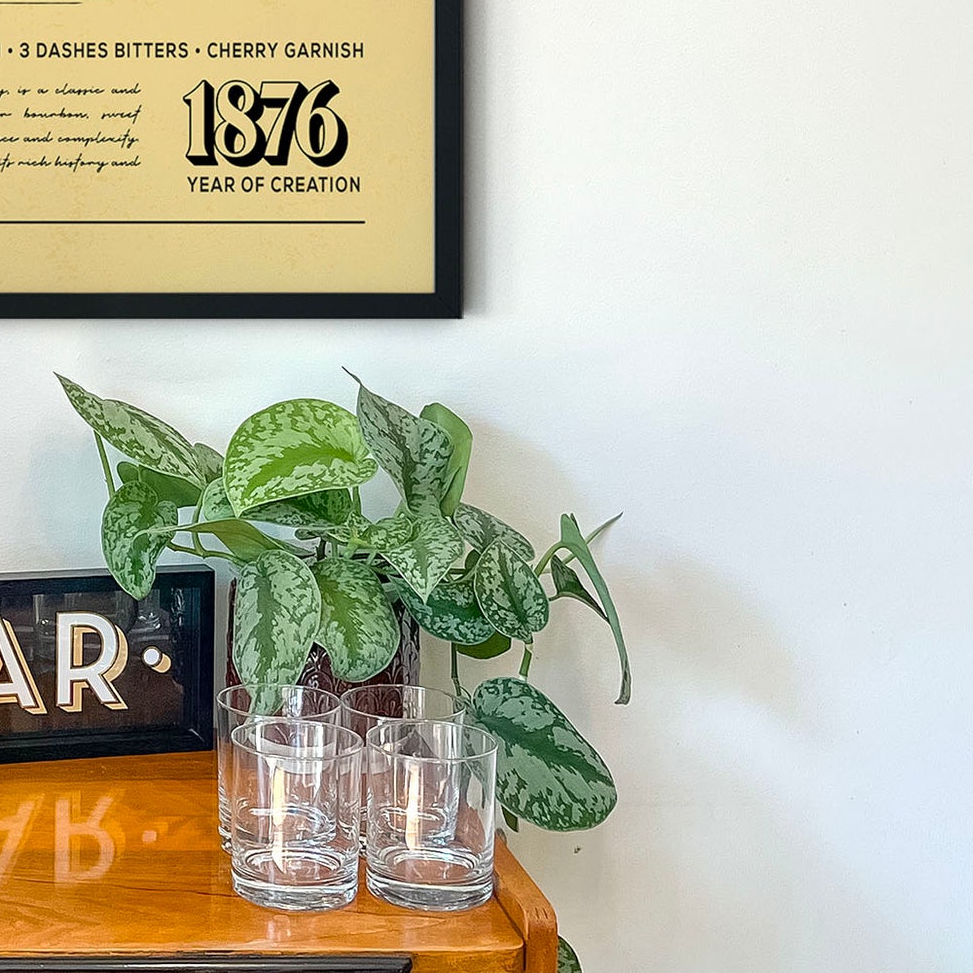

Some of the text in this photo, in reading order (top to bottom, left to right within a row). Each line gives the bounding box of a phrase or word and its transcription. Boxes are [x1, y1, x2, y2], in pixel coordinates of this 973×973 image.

[19, 42, 30, 59] 3
[36, 42, 108, 59] DASHES
[114, 42, 189, 59] BITTERS
[207, 42, 279, 59] CHERRY
[285, 42, 364, 59] GARNISH
[17, 85, 31, 95] is
[54, 82, 105, 95] classic
[110, 82, 142, 95] and
[101, 104, 142, 125] sweet
[182, 79, 349, 168] 1876
[22, 131, 54, 143] and
[17, 155, 52, 167] rich
[54, 152, 109, 174] history
[110, 155, 142, 167] and
[186, 176, 361, 193] YEAR OF CREATION
